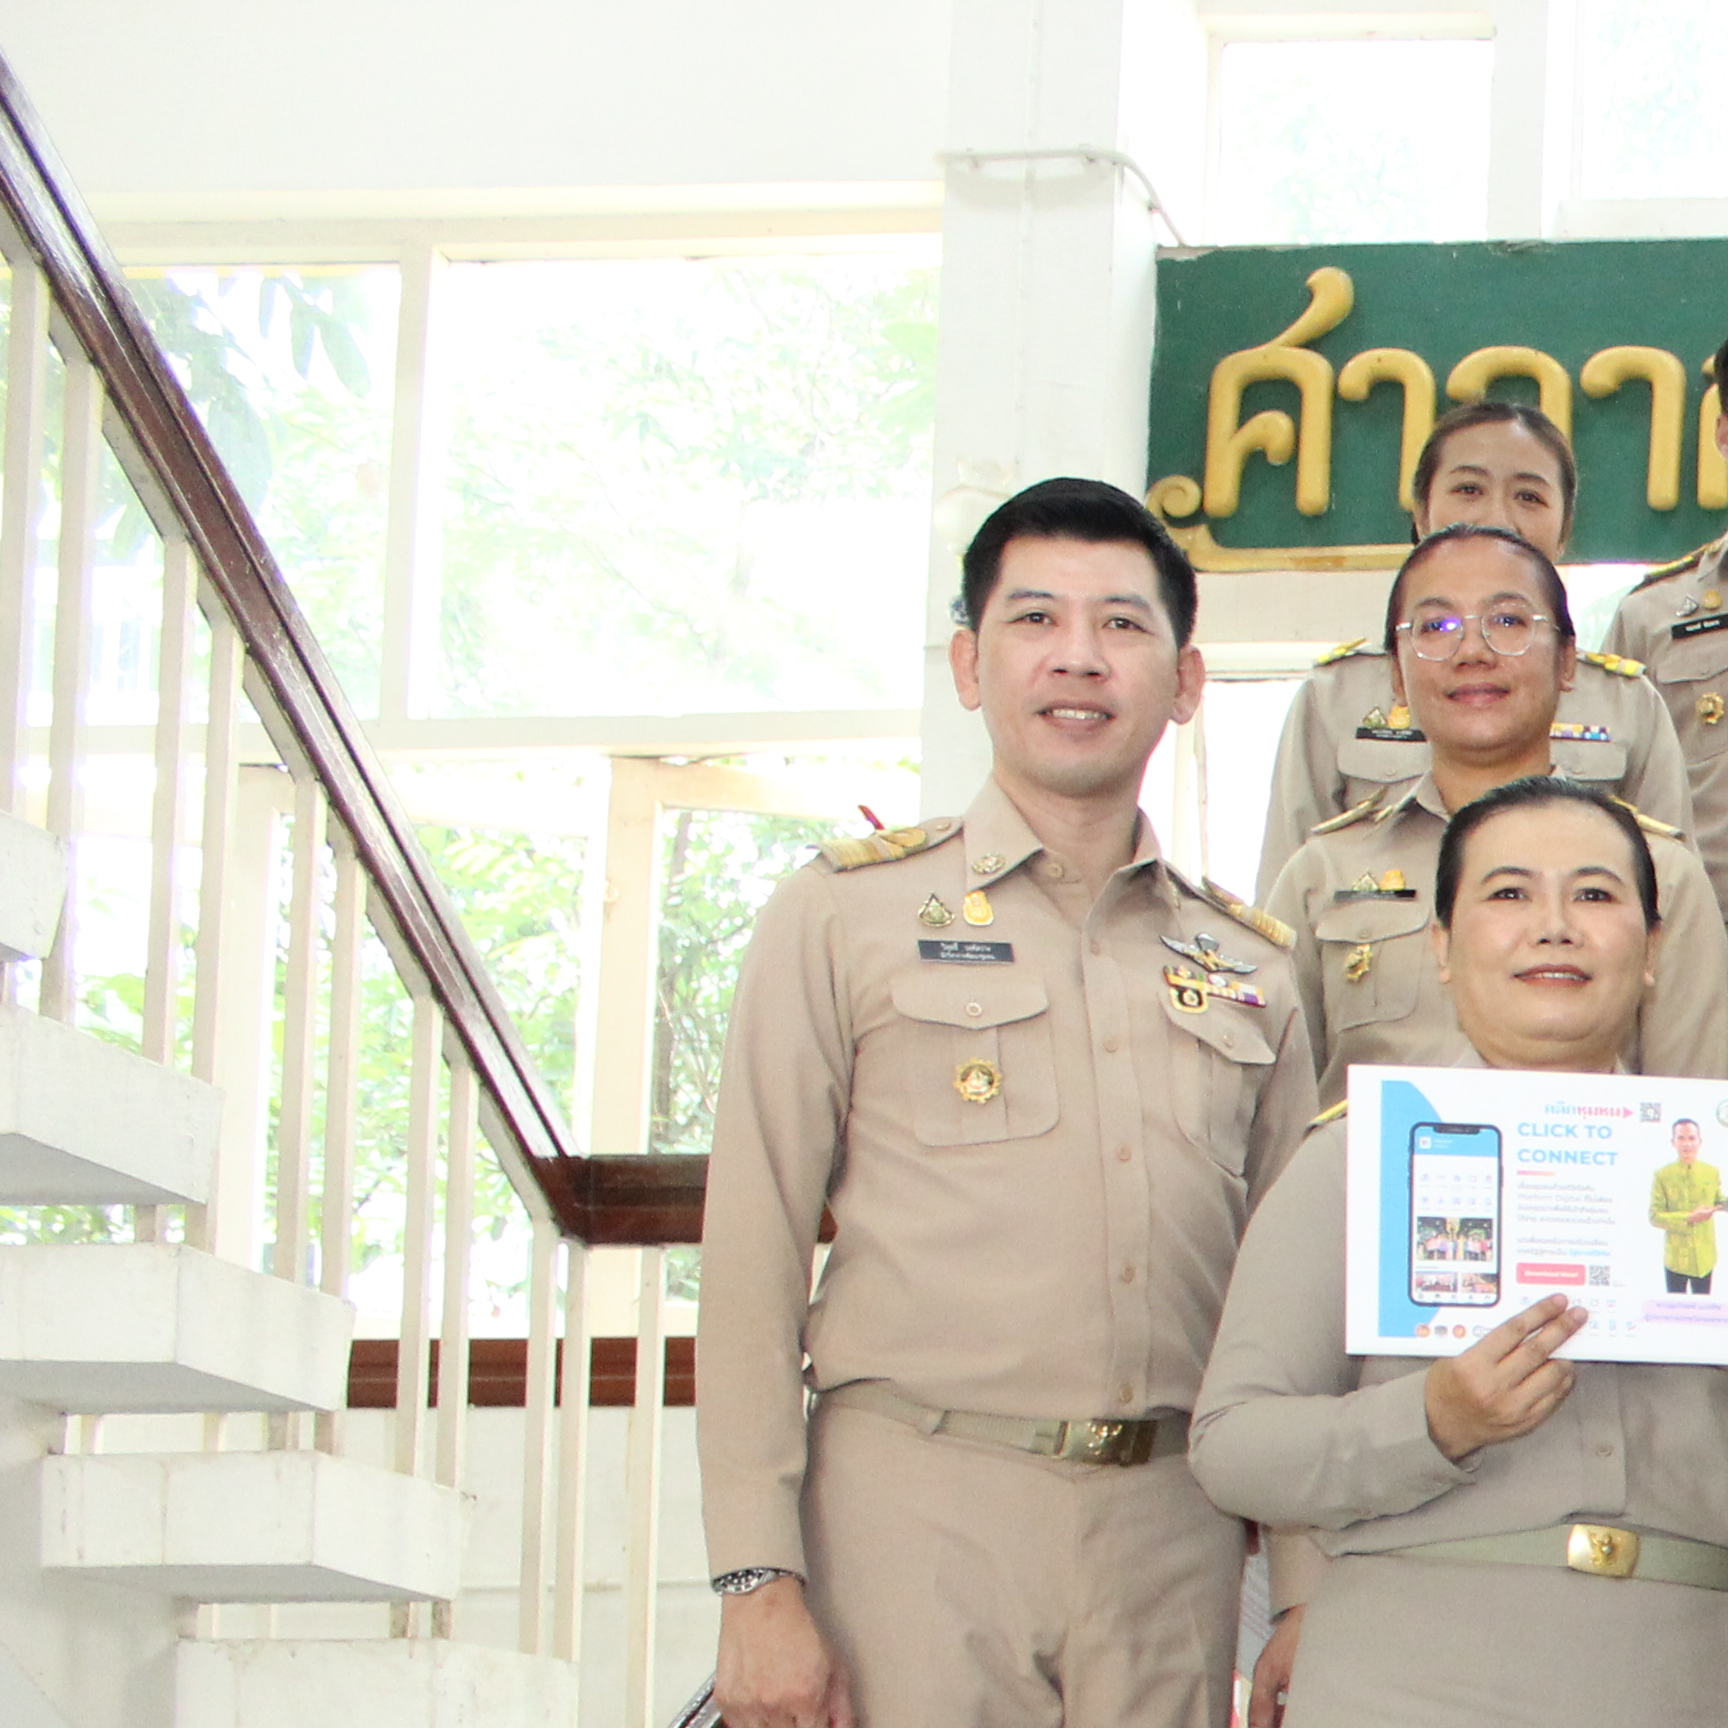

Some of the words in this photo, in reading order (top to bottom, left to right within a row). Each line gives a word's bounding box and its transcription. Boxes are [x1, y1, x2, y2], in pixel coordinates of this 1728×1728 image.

[1517, 1122, 1578, 1138] CLICK
[1584, 1124, 1612, 1139] TO
[1517, 1148, 1618, 1165] CONNECT
